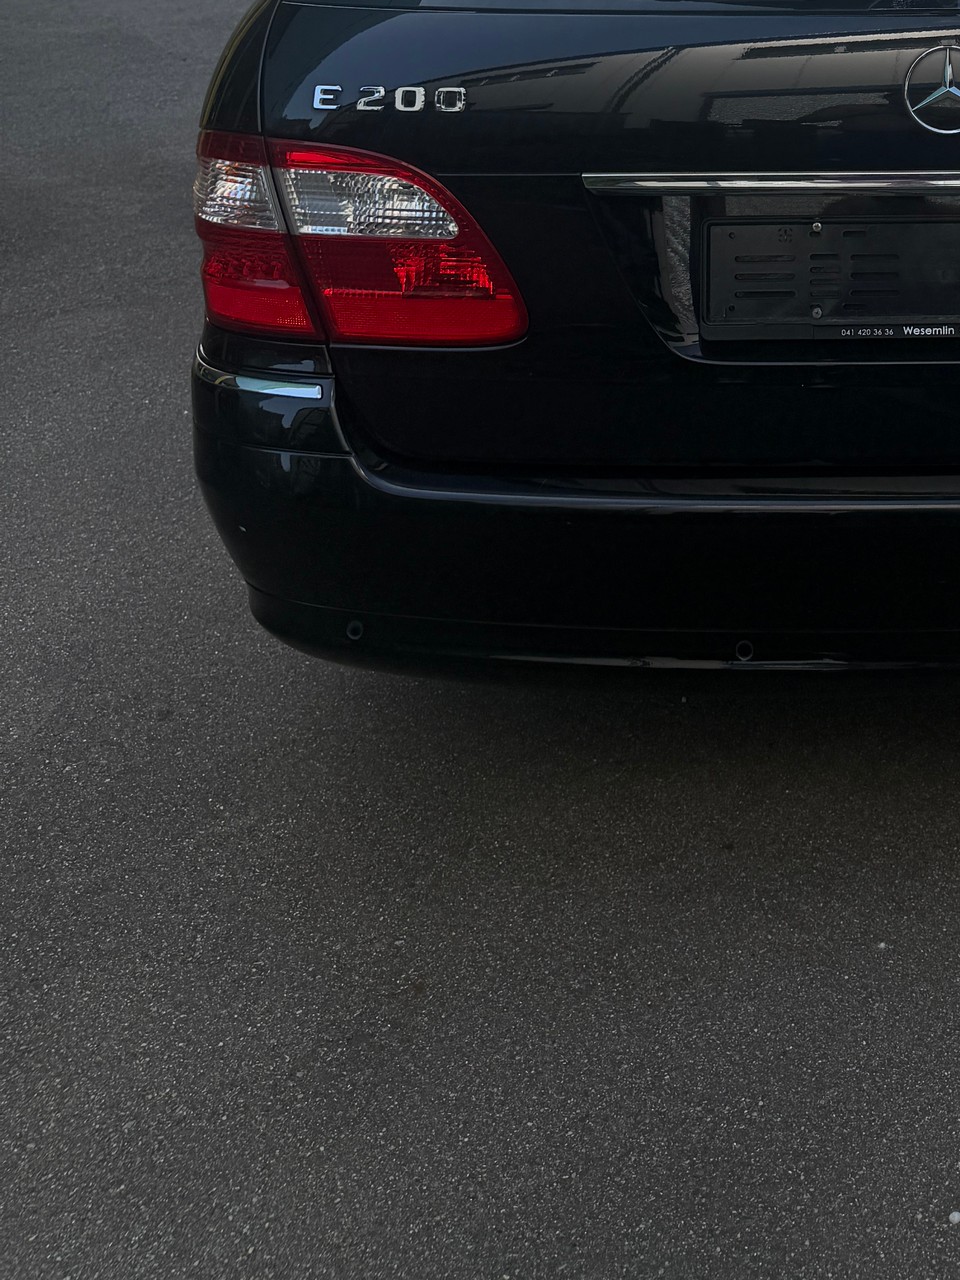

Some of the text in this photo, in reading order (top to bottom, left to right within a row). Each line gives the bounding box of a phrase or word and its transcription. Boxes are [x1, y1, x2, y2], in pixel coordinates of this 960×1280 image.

[313, 84, 467, 113] E 200
[841, 328, 854, 337] 041
[857, 328, 871, 337] 420
[873, 328, 883, 337] 36
[884, 328, 894, 337] 36
[902, 325, 955, 336] Wesemlin
